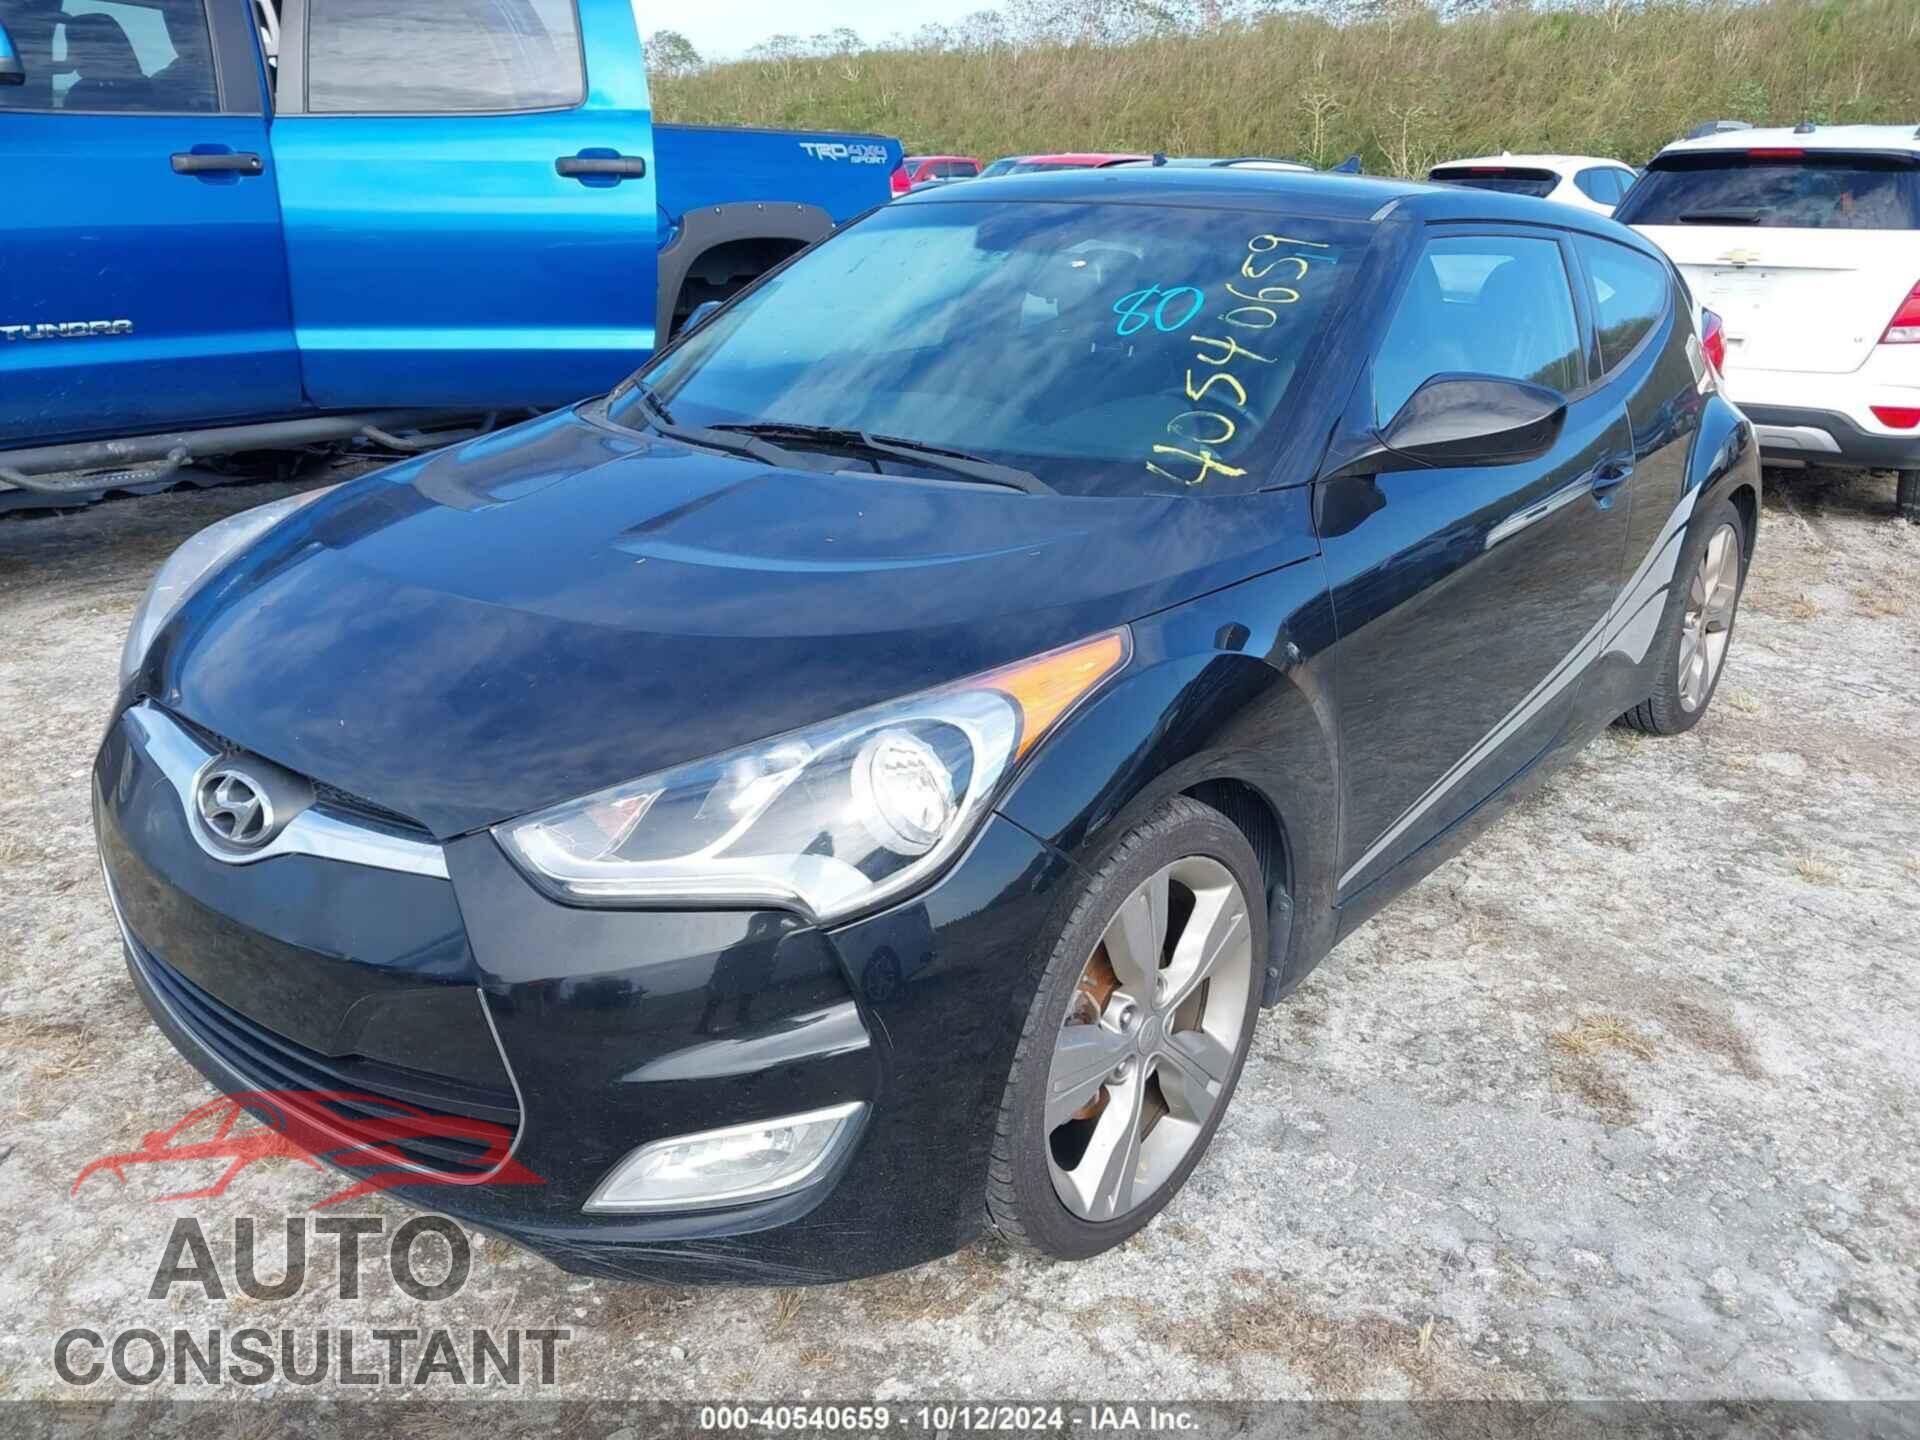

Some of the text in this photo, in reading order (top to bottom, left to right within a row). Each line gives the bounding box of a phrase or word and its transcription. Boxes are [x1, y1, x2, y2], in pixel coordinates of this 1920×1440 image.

[798, 142, 848, 161] TRD
[850, 155, 887, 164] SPORT
[1112, 283, 1206, 337] 80
[0, 319, 134, 341] TUNDRA
[1145, 233, 1330, 486] 40540659
